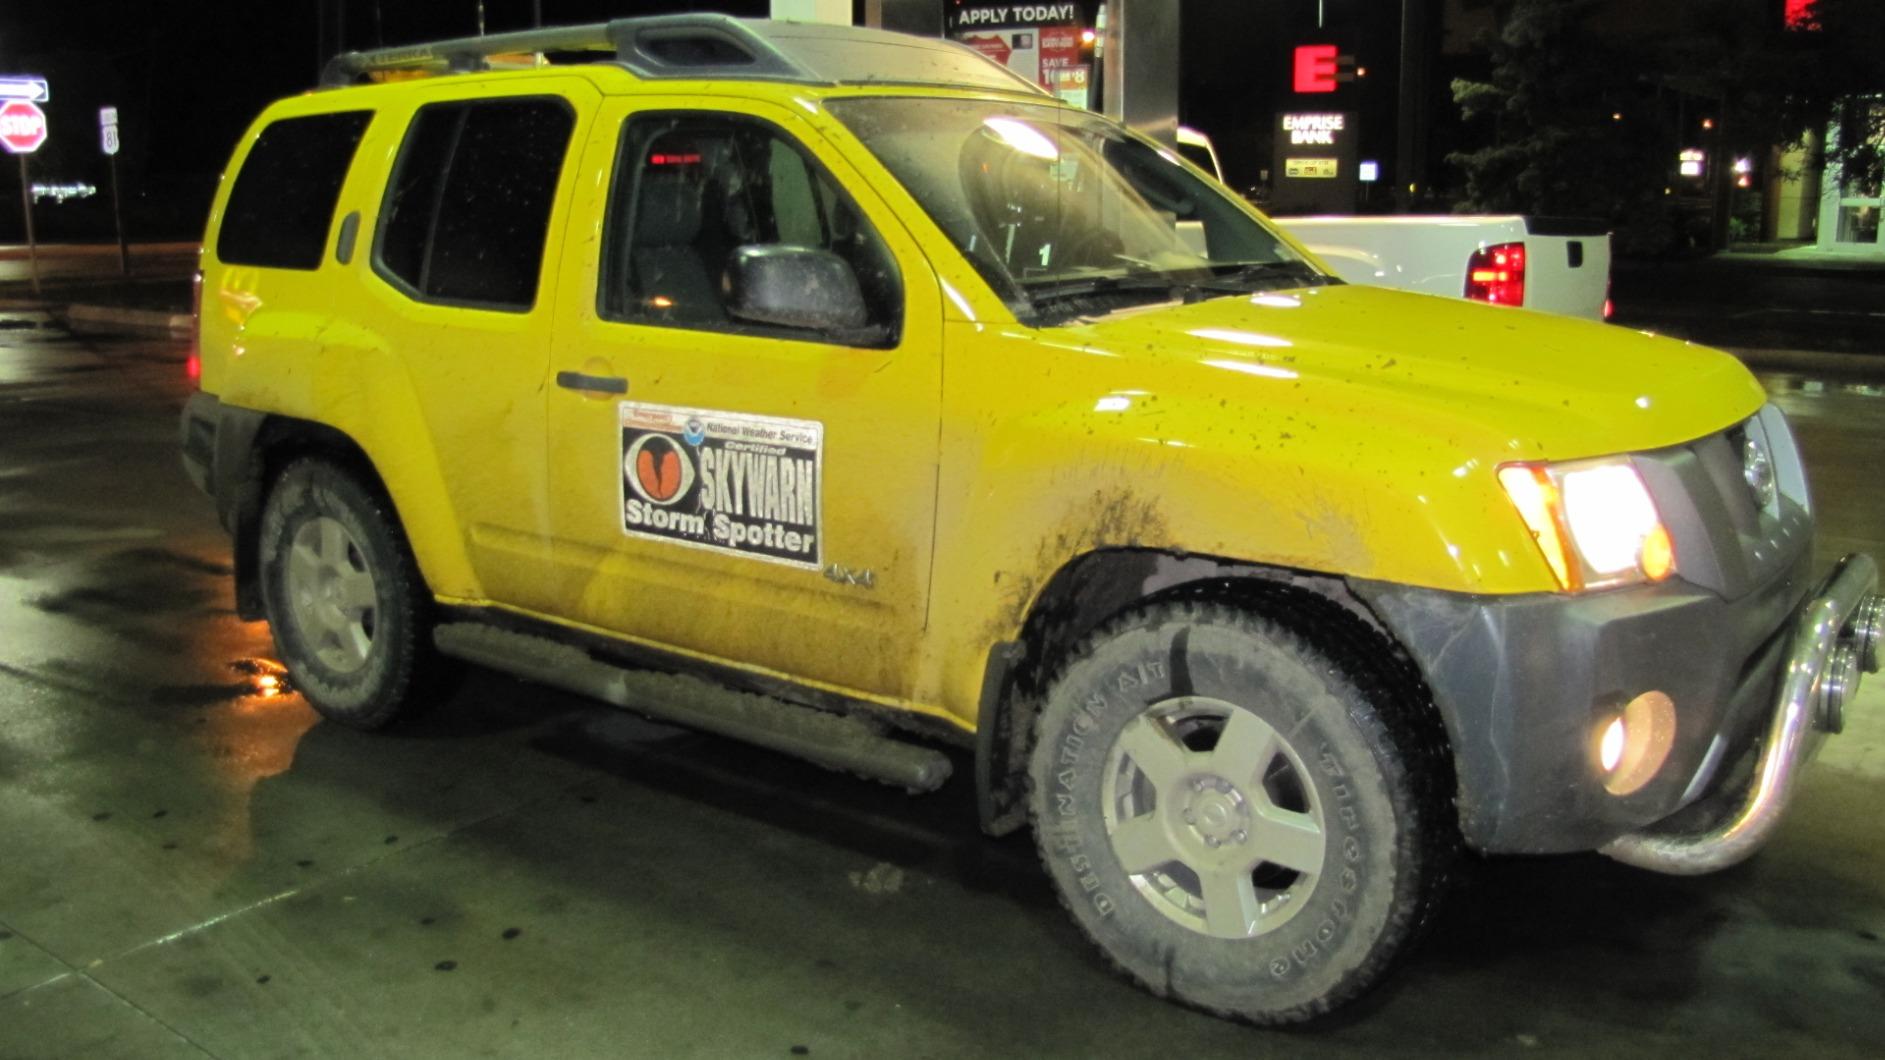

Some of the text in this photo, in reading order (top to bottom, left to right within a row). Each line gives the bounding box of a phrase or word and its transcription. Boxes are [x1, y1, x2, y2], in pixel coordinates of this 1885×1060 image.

[959, 5, 1075, 25] APPLY TODAY!
[1042, 58, 1069, 68] SAVE
[1294, 45, 1337, 92] E
[1, 114, 43, 135] STOP
[1283, 113, 1344, 130] EMPRISE
[1291, 130, 1334, 144] BANK
[707, 422, 813, 444] National Weather Service
[724, 441, 786, 457] Certified
[700, 447, 814, 527] SKYWARN
[626, 498, 815, 553] Storm Spotter
